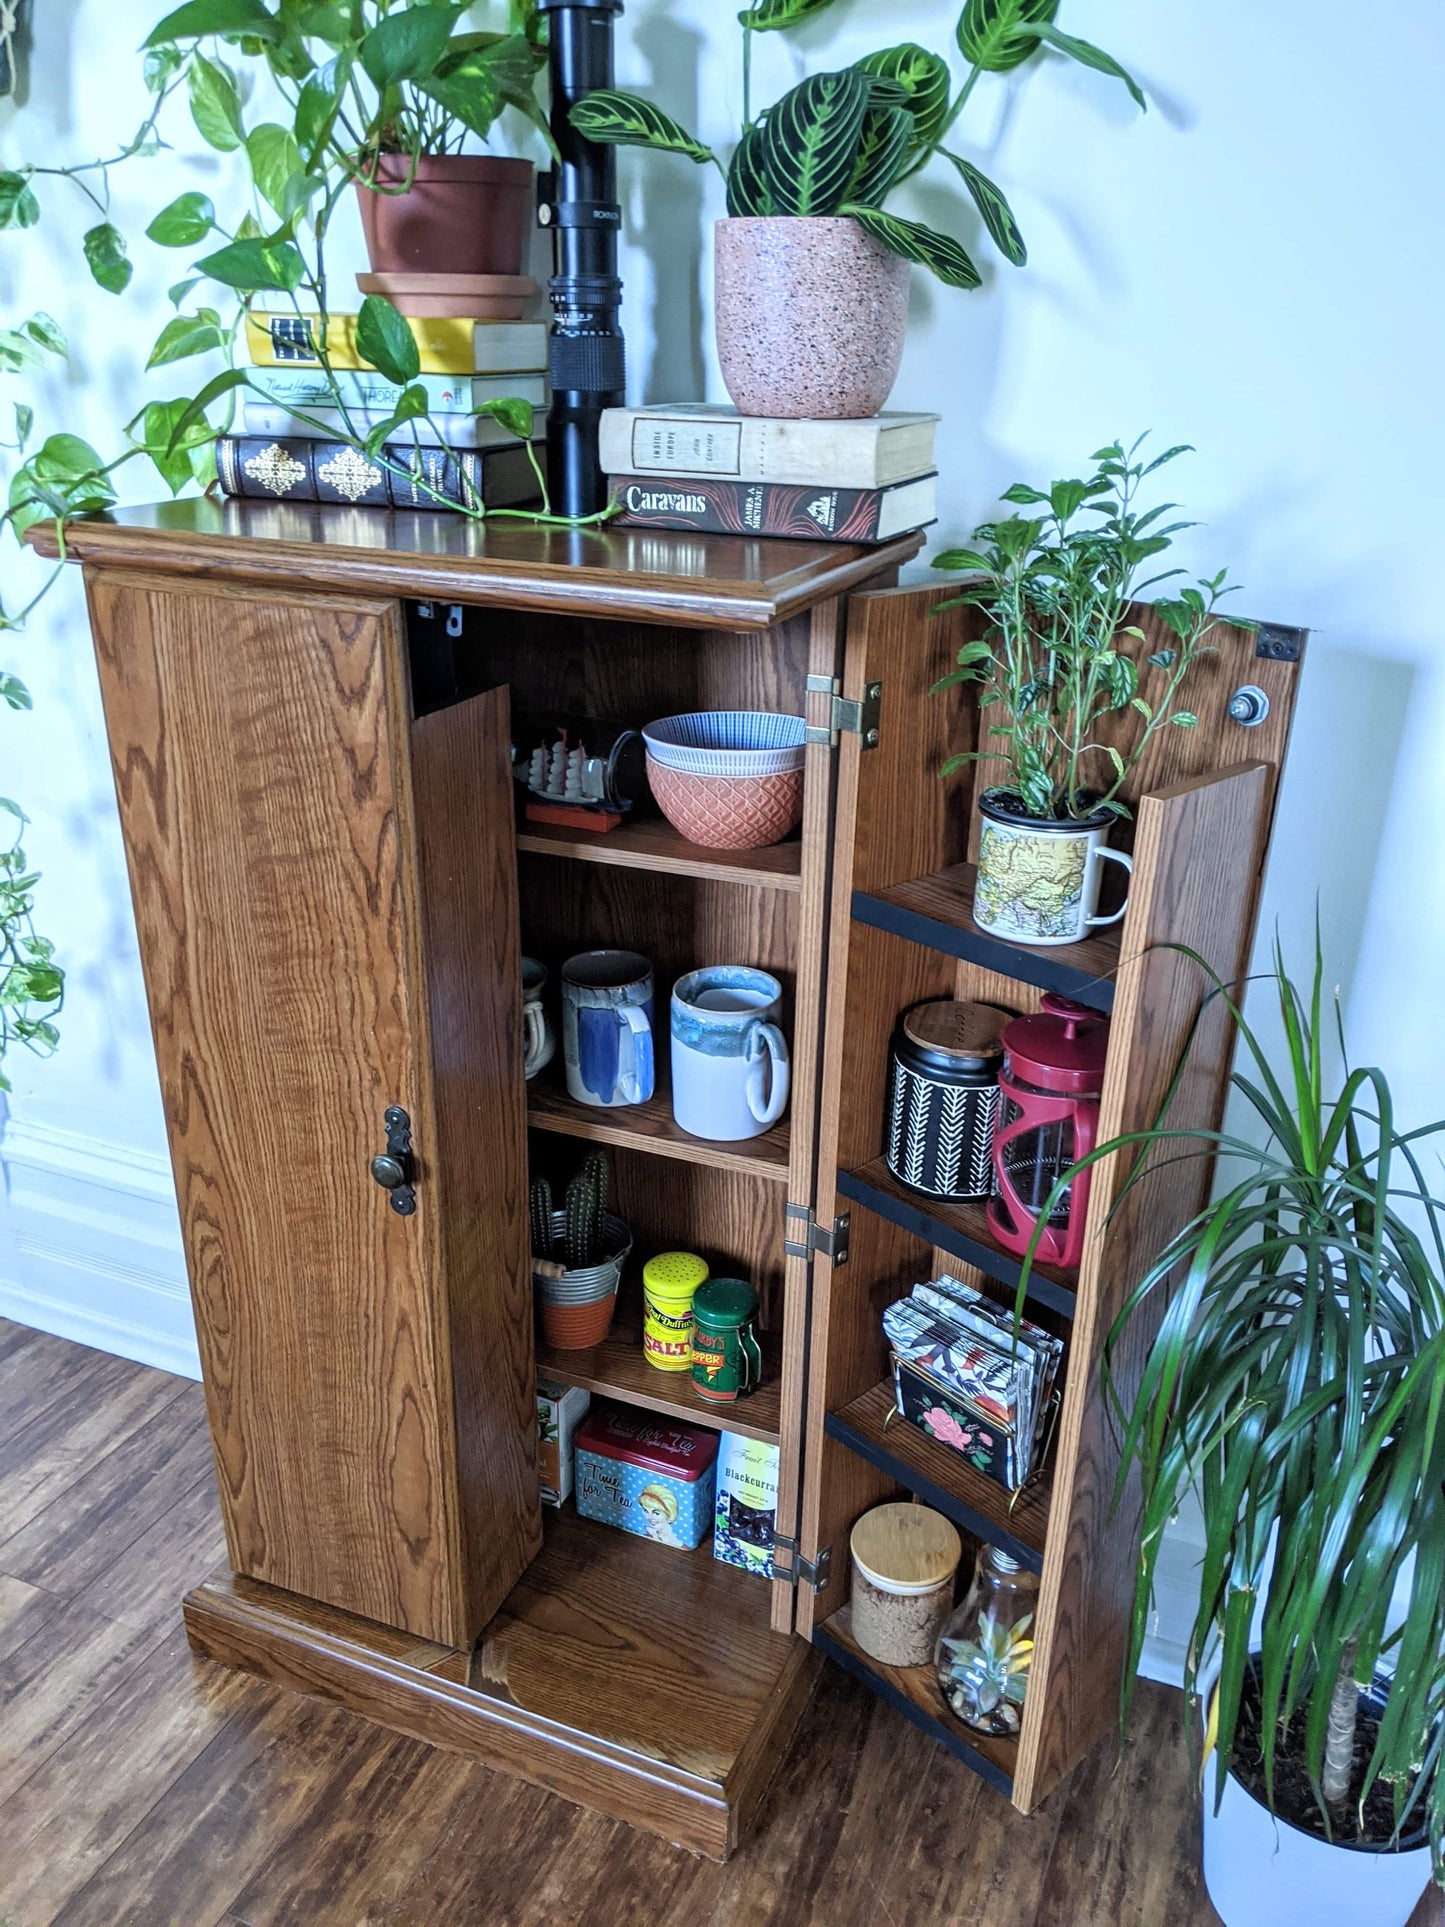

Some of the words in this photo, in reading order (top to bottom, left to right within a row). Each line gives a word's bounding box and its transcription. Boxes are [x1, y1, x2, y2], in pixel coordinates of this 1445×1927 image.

[653, 431, 662, 459] INSIDE
[666, 432, 675, 460] EUROPE
[626, 486, 706, 513] Caravans
[643, 1332, 691, 1356] SALT
[733, 1448, 762, 1463] Fruit
[584, 1462, 620, 1487] Time
[725, 1467, 776, 1492] Blackcurra
[583, 1478, 601, 1499] for
[605, 1486, 632, 1508] Tea
